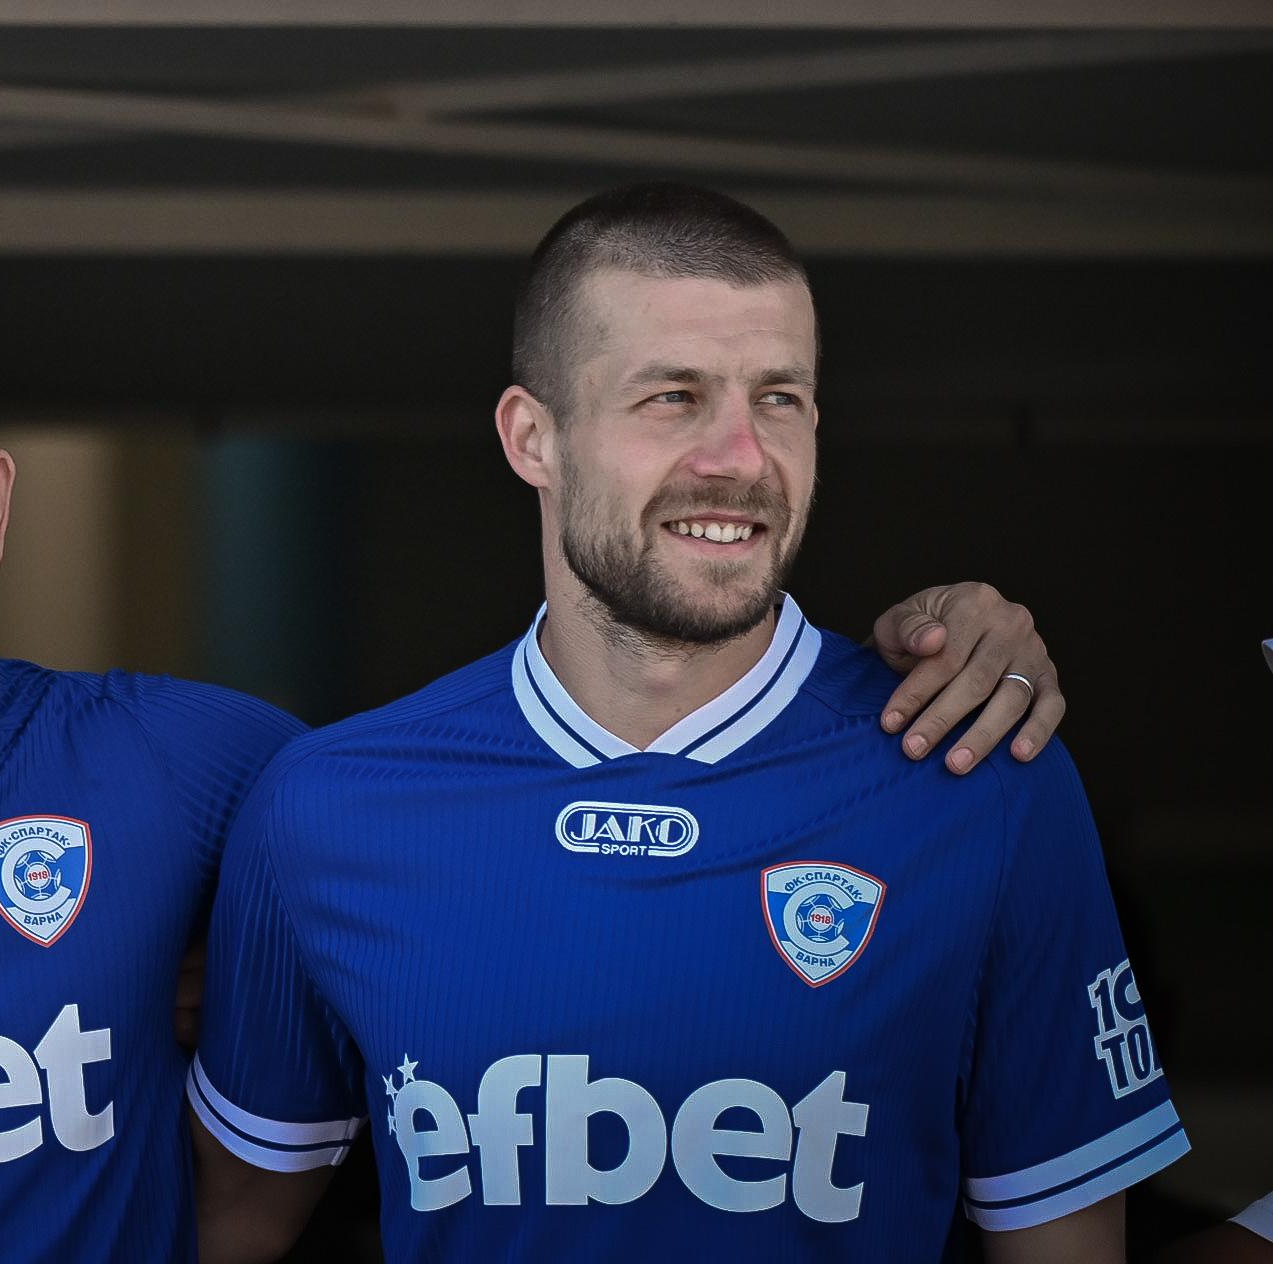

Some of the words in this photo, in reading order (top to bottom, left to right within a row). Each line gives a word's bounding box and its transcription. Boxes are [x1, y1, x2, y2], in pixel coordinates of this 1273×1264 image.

[570, 813, 687, 846] JAKO
[600, 843, 648, 856] SPORT
[27, 870, 49, 882] 1918
[23, 911, 64, 926] ВАРНА
[810, 913, 833, 925] 1918
[795, 951, 837, 967] ВАРНА
[394, 1053, 870, 1223] efbet
